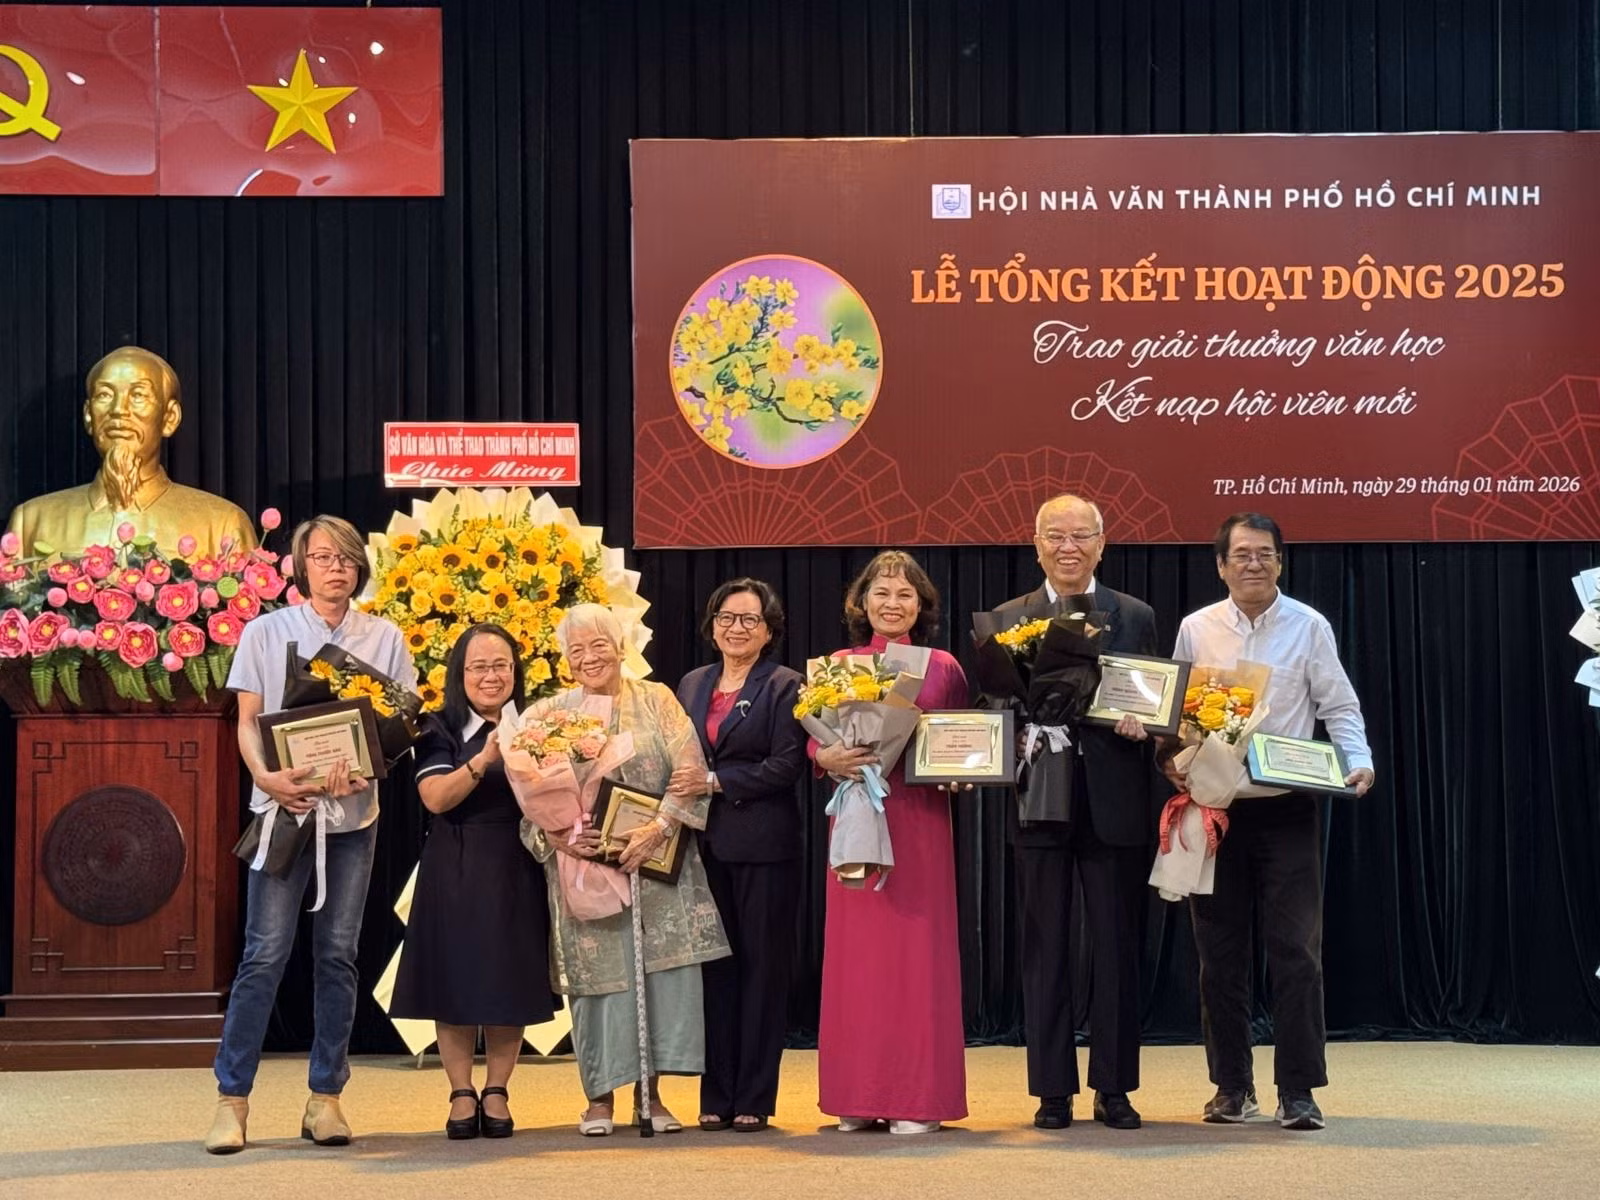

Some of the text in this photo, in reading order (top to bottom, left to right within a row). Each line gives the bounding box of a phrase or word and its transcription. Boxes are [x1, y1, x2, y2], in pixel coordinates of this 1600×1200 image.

[978, 179, 1540, 215] HỘI NHÀ VĂN THÀNH PHỐ HỒ CHÍ MINH
[910, 252, 1565, 312] LỄ TỔNG KẾT HOẠT ĐỘNG 2025
[1033, 320, 1447, 369] Trao giải thưởng văn học
[1070, 376, 1418, 426] Kết nạp hội viên mới
[389, 428, 576, 456] SỞ VĂN HÓA VÀ THỂ THAO THÀNH PHỐ HỒ CHÍ MINH
[400, 461, 567, 481] Chúc Mừng
[1213, 475, 1581, 497] TP. Hồ Chí Minh, ngày 29 tháng 01 năm 2026
